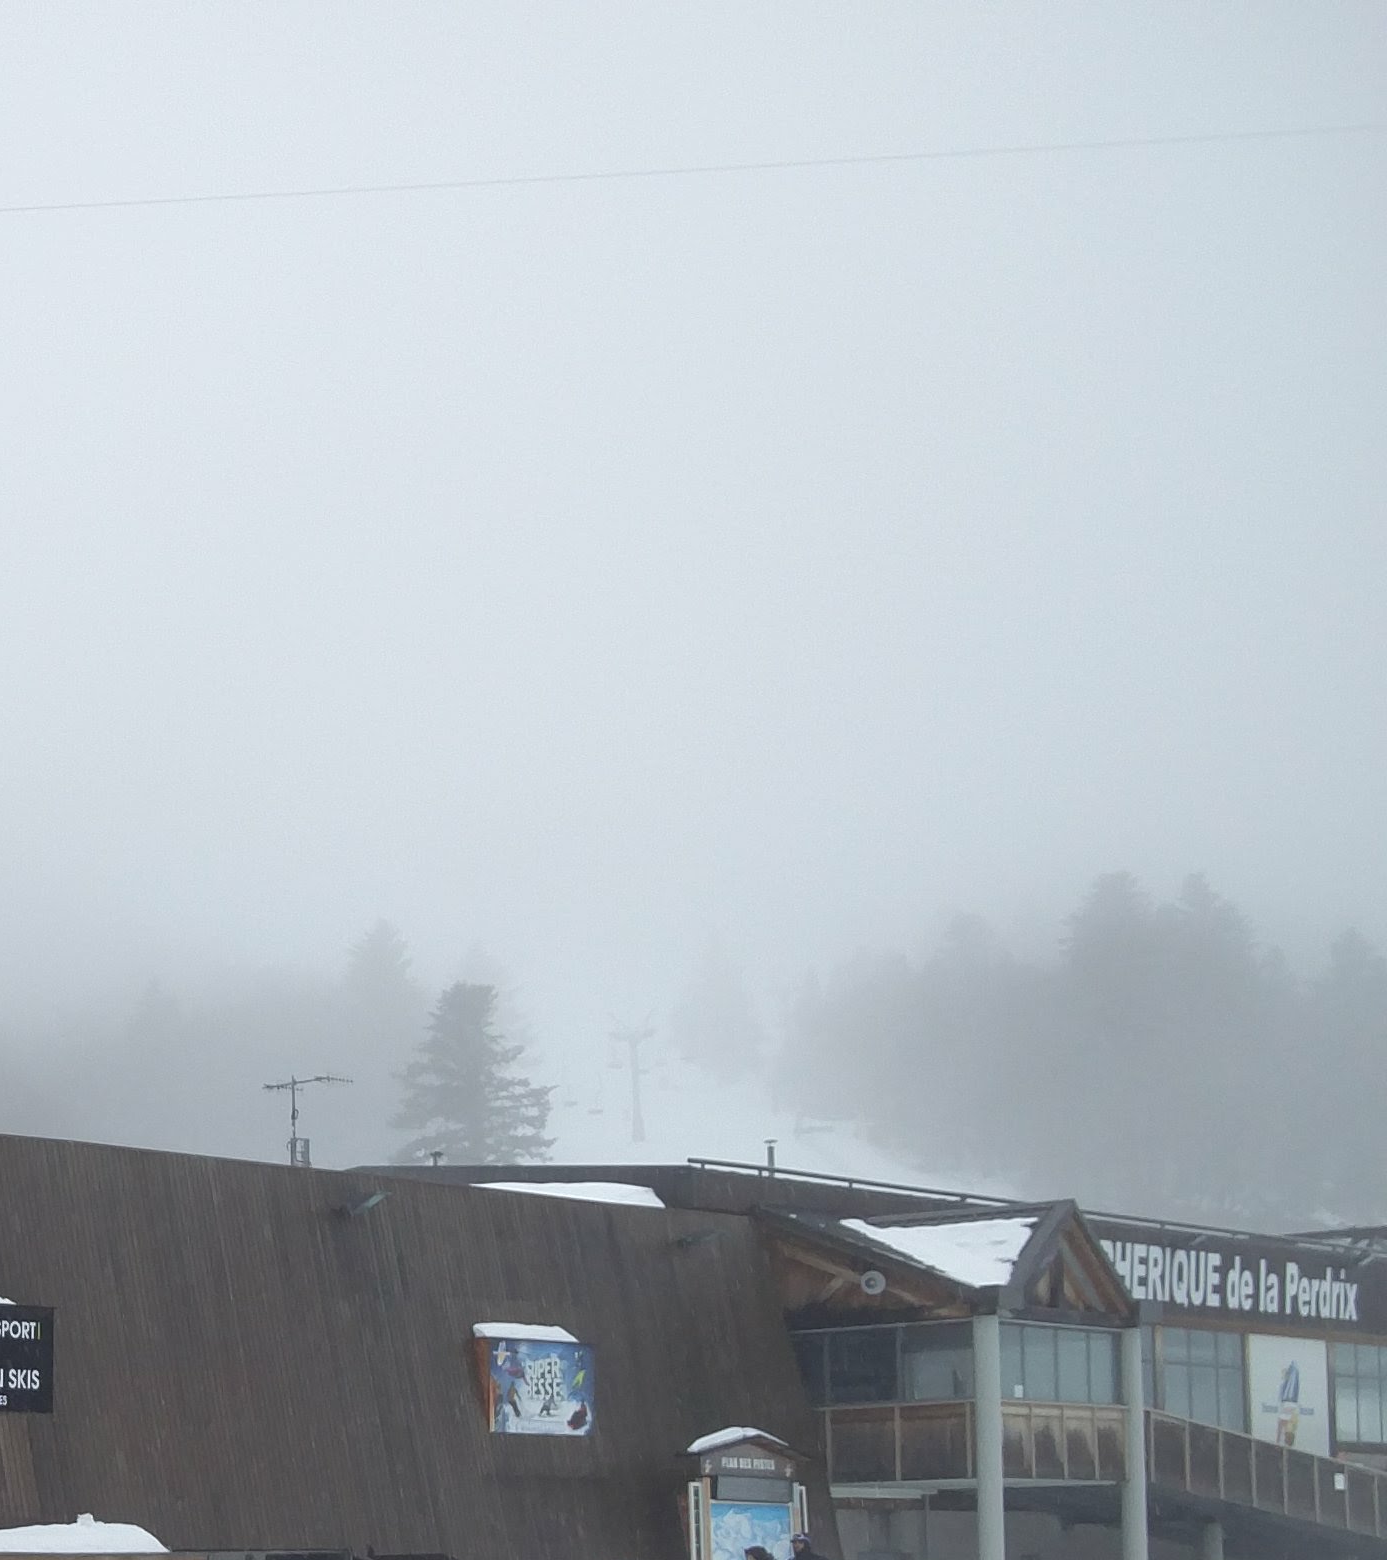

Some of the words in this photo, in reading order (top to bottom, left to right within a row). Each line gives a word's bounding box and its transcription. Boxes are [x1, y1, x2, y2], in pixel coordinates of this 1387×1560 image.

[1227, 1255, 1254, 1311] de
[1259, 1258, 1278, 1314] la
[1285, 1262, 1358, 1321] Perdrix
[8, 1368, 40, 1390] SKIS
